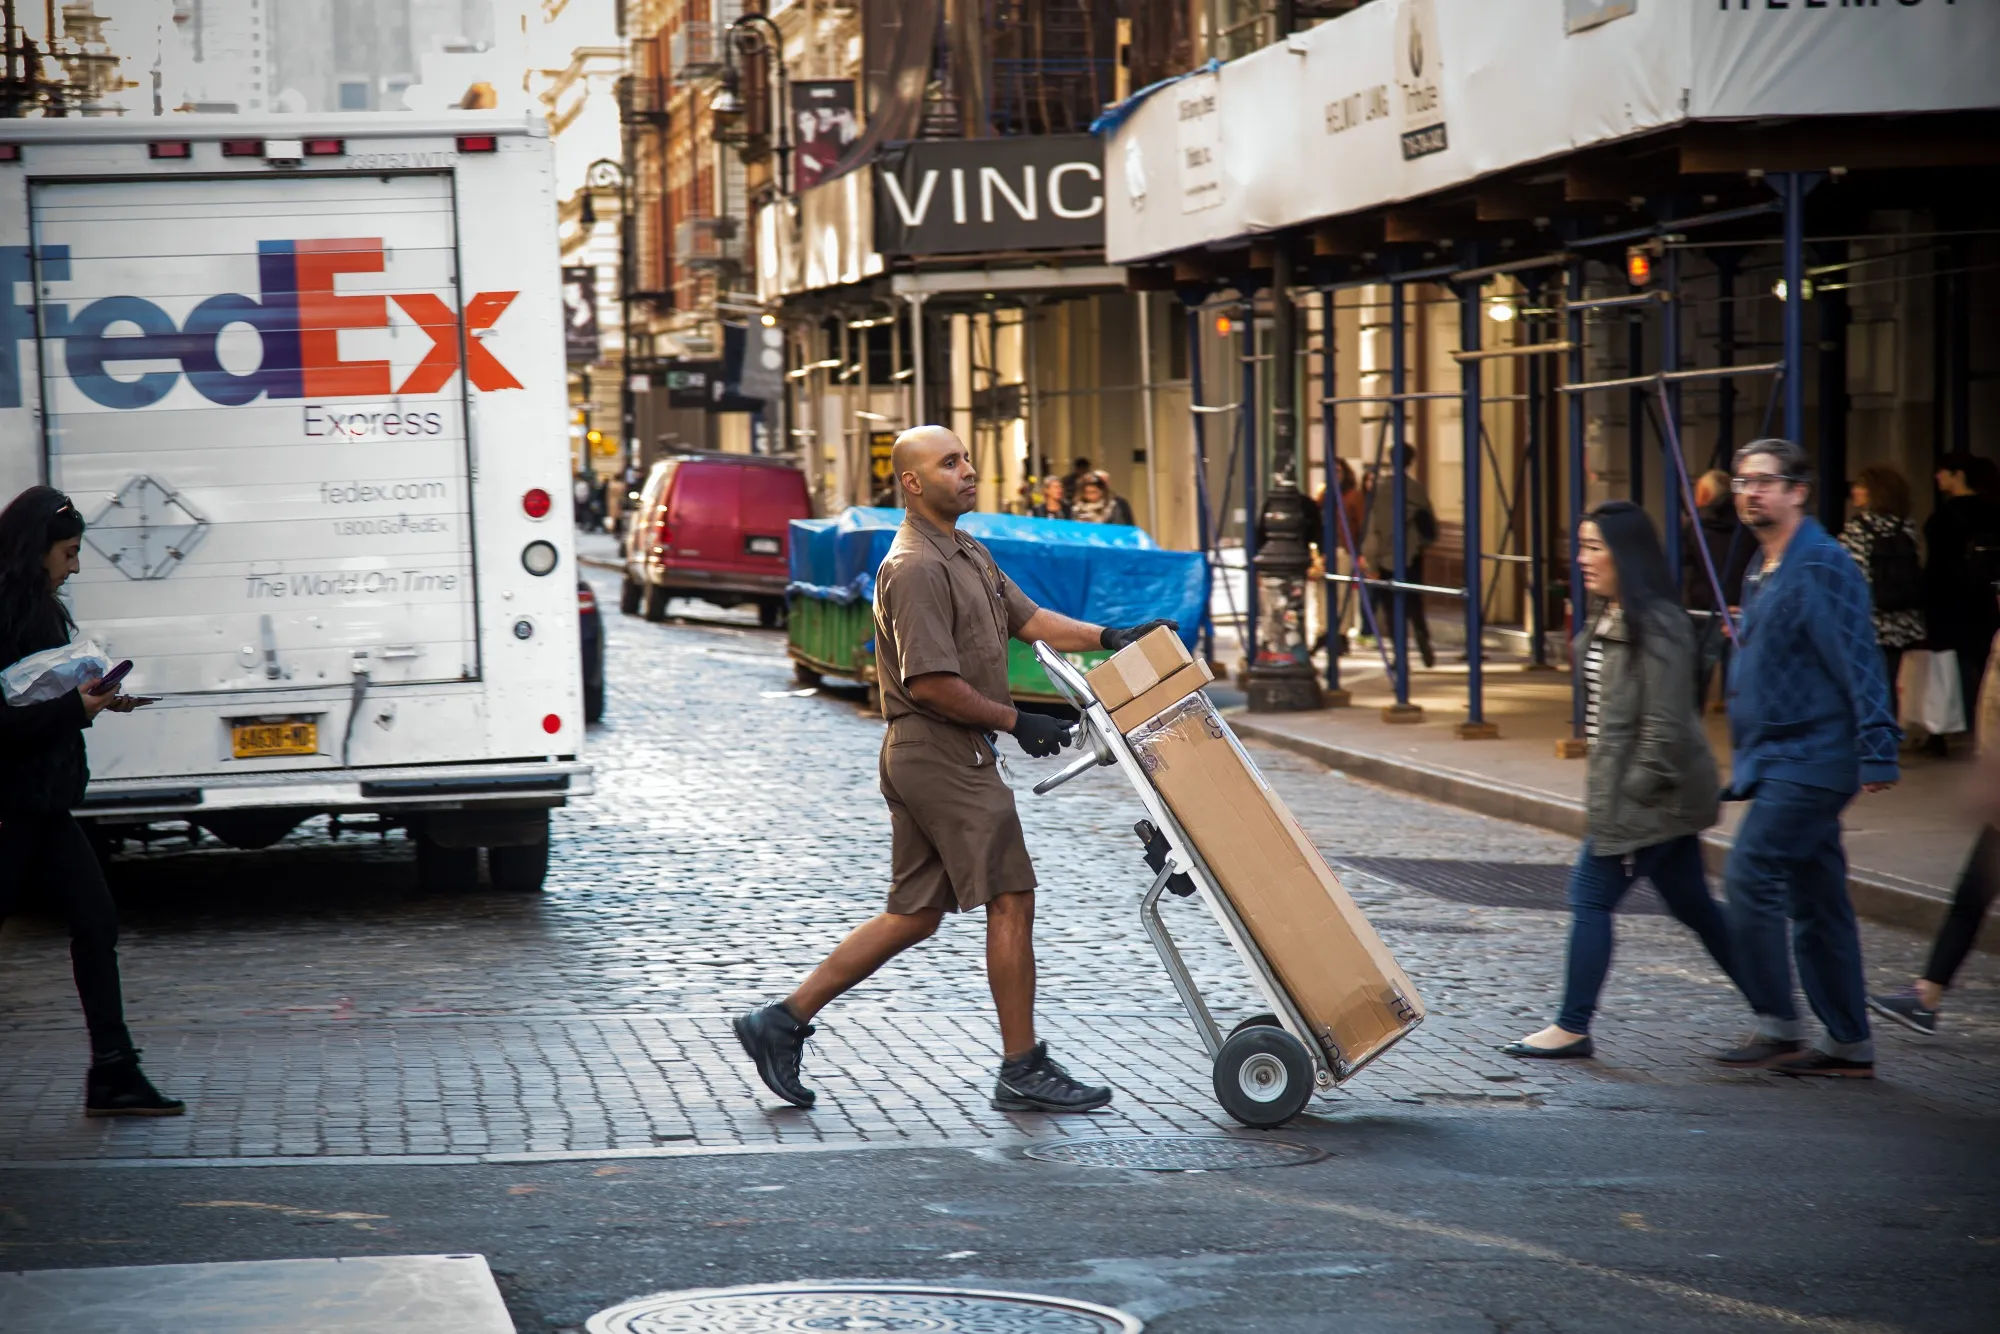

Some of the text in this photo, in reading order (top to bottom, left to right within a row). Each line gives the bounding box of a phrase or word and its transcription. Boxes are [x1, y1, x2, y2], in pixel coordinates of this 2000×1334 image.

[884, 161, 1104, 227] VINC
[0, 237, 525, 409] FedEx
[304, 405, 442, 443] Express
[319, 481, 447, 504] fedex.com
[246, 570, 458, 599] The World On Time
